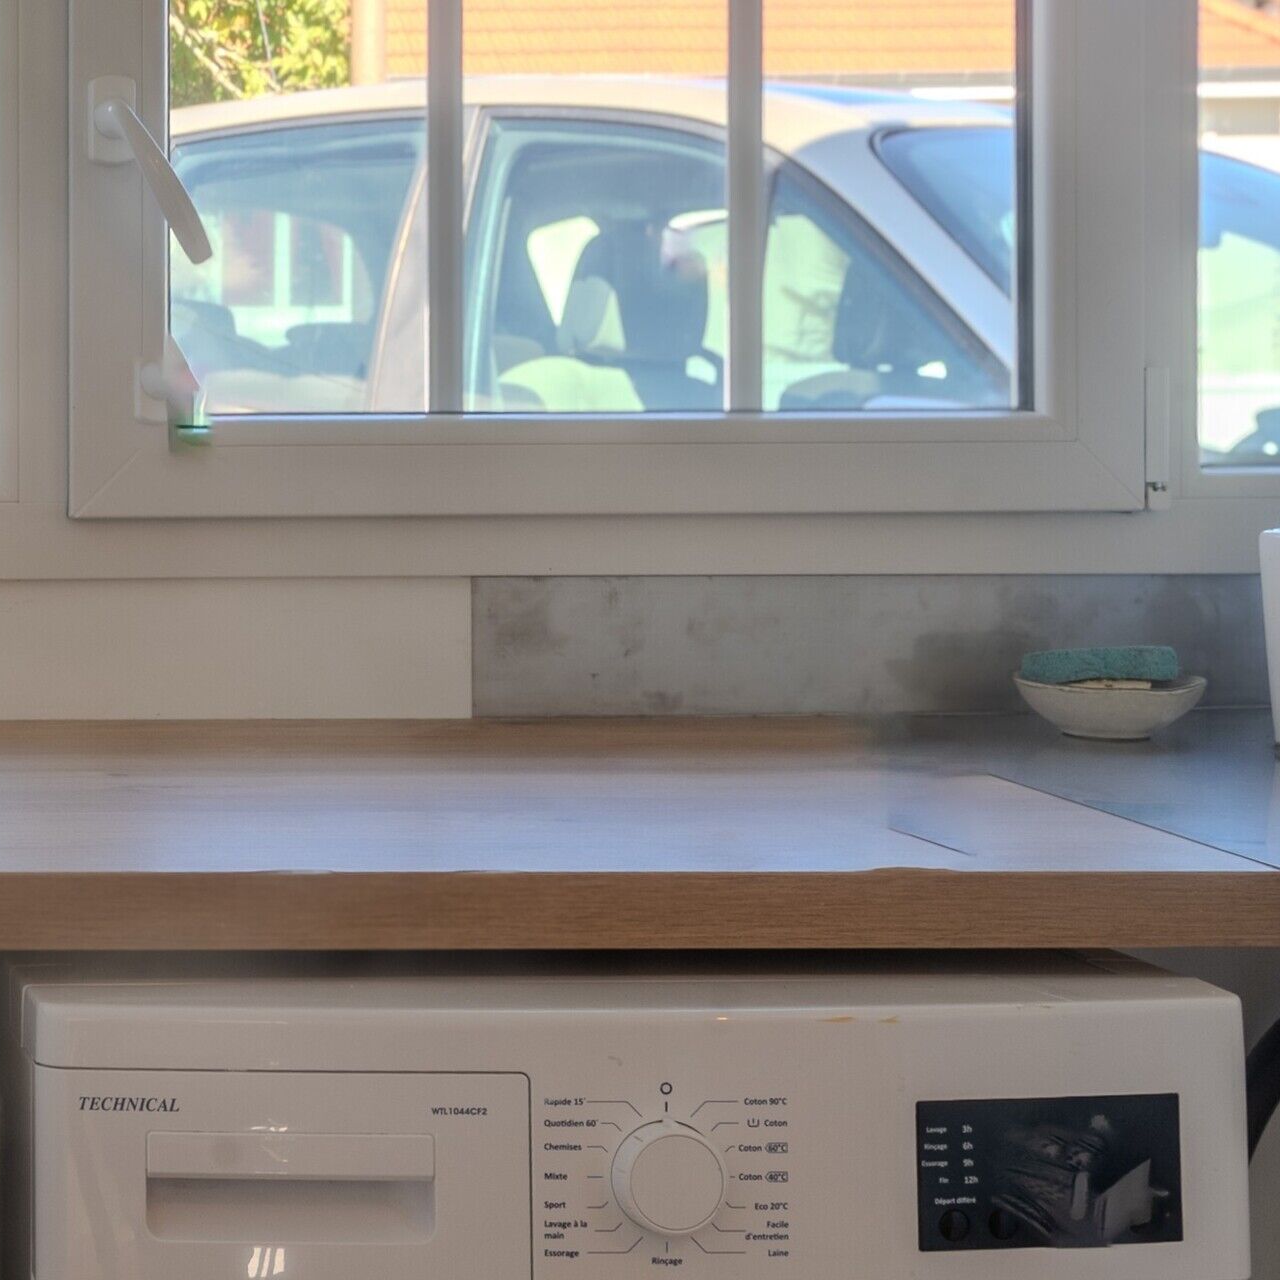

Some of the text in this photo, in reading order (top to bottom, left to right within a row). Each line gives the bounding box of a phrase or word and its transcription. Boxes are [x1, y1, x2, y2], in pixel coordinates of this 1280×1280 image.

[79, 1096, 180, 1112] TECHNICAL
[544, 1119, 584, 1127] Quotidien
[543, 1142, 582, 1151] Chemises
[544, 1201, 566, 1210] Sport
[544, 1220, 571, 1230] Lavage
[580, 1219, 588, 1228] la
[766, 1221, 789, 1229] Facile
[544, 1232, 565, 1240] main
[544, 1249, 580, 1259] Essorage
[768, 1249, 789, 1257] Laine
[652, 1257, 683, 1267] Rinçage
